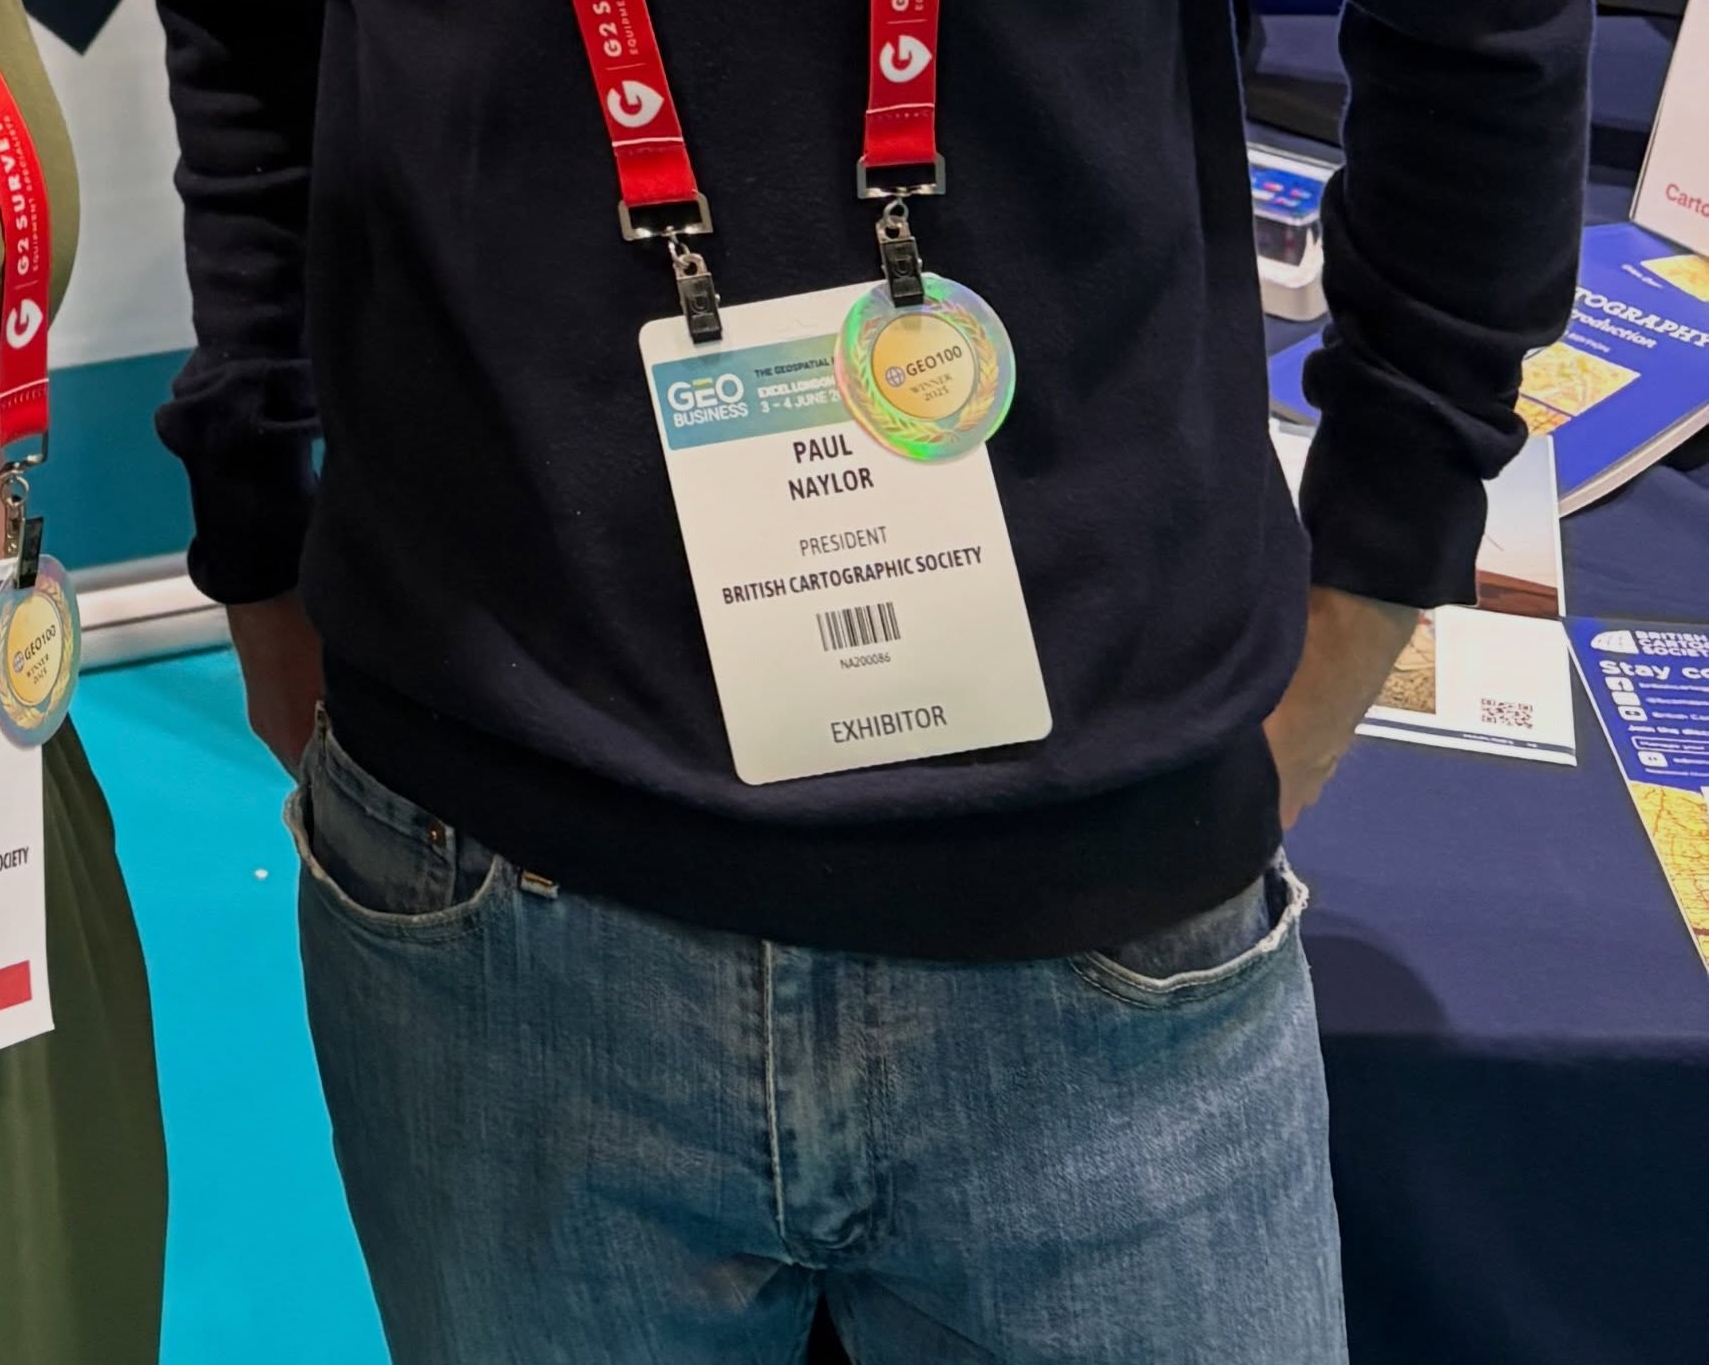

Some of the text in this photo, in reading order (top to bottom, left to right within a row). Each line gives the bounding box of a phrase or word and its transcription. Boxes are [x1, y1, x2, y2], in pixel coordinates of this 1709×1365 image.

[604, 19, 623, 58] G2
[17, 237, 31, 277] G2
[753, 366, 774, 379] THE
[905, 345, 963, 377] GEO100
[667, 372, 745, 412] GEO
[794, 392, 828, 410] JUNE
[673, 402, 750, 429] BUSINESS
[793, 433, 854, 464] PAUL
[788, 466, 876, 502] NAYLOR
[799, 525, 889, 557] PRESIDENT
[722, 545, 985, 606] BRITISH CARTOGRAPHIC SOCIETY
[24, 624, 57, 661] GEO100
[1599, 659, 1671, 681] Stay
[830, 705, 949, 744] EXHIBITOR
